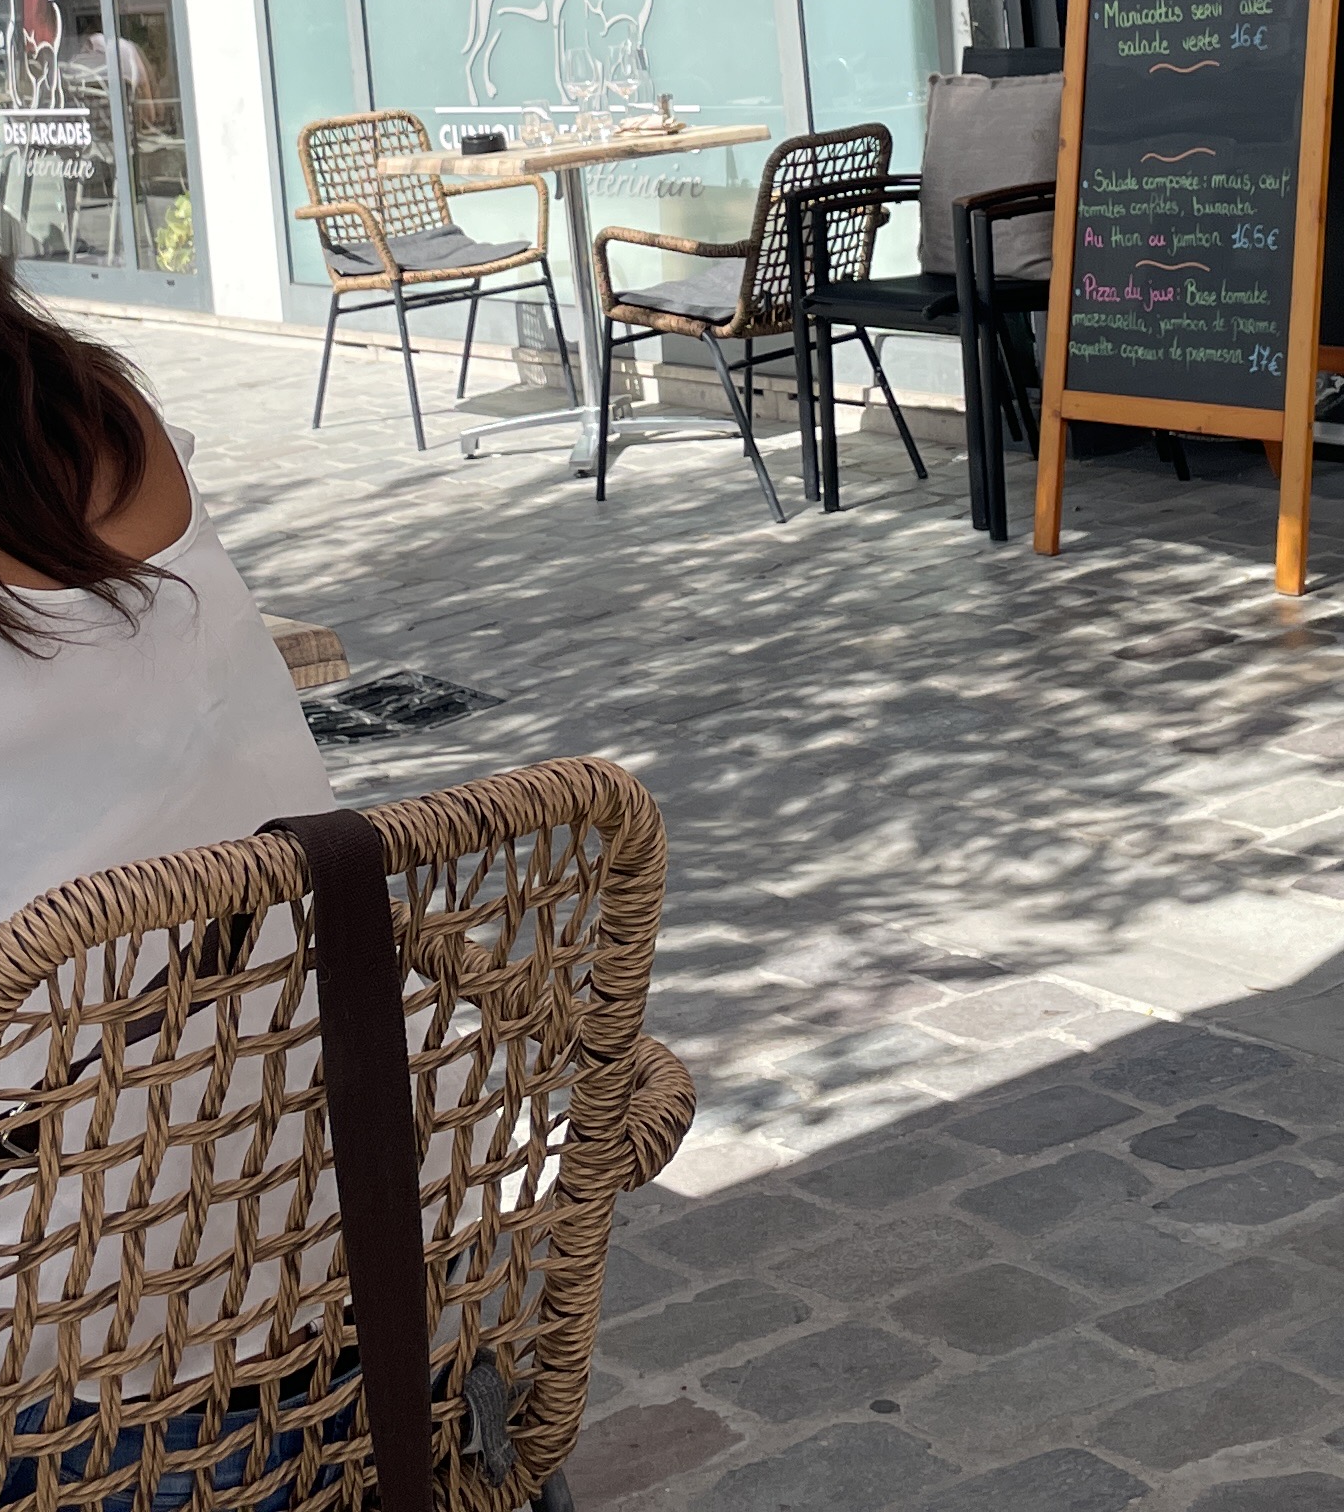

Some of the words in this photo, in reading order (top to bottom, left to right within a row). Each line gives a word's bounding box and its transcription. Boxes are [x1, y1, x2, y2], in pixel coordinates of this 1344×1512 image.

[1104, 0, 1183, 28] Manicottis
[1118, 30, 1170, 57] salade
[1182, 27, 1220, 51] verte
[1230, 23, 1268, 50] 16€
[4, 122, 27, 145] DES
[31, 122, 92, 145] ARCADES
[1093, 168, 1138, 192] Salade
[1078, 198, 1126, 218] tomates
[1084, 226, 1104, 247] Au
[1111, 224, 1142, 247] thon
[1148, 234, 1166, 246] ou
[1167, 222, 1222, 257] jambon
[1083, 272, 1120, 302] Pizza
[1124, 273, 1143, 302] du
[1184, 278, 1217, 306] Base
[1156, 312, 1208, 338] jambon
[1212, 310, 1227, 331] de
[1169, 336, 1182, 360] de
[1186, 346, 1244, 371] parmesan
[1249, 343, 1284, 377] 17€
